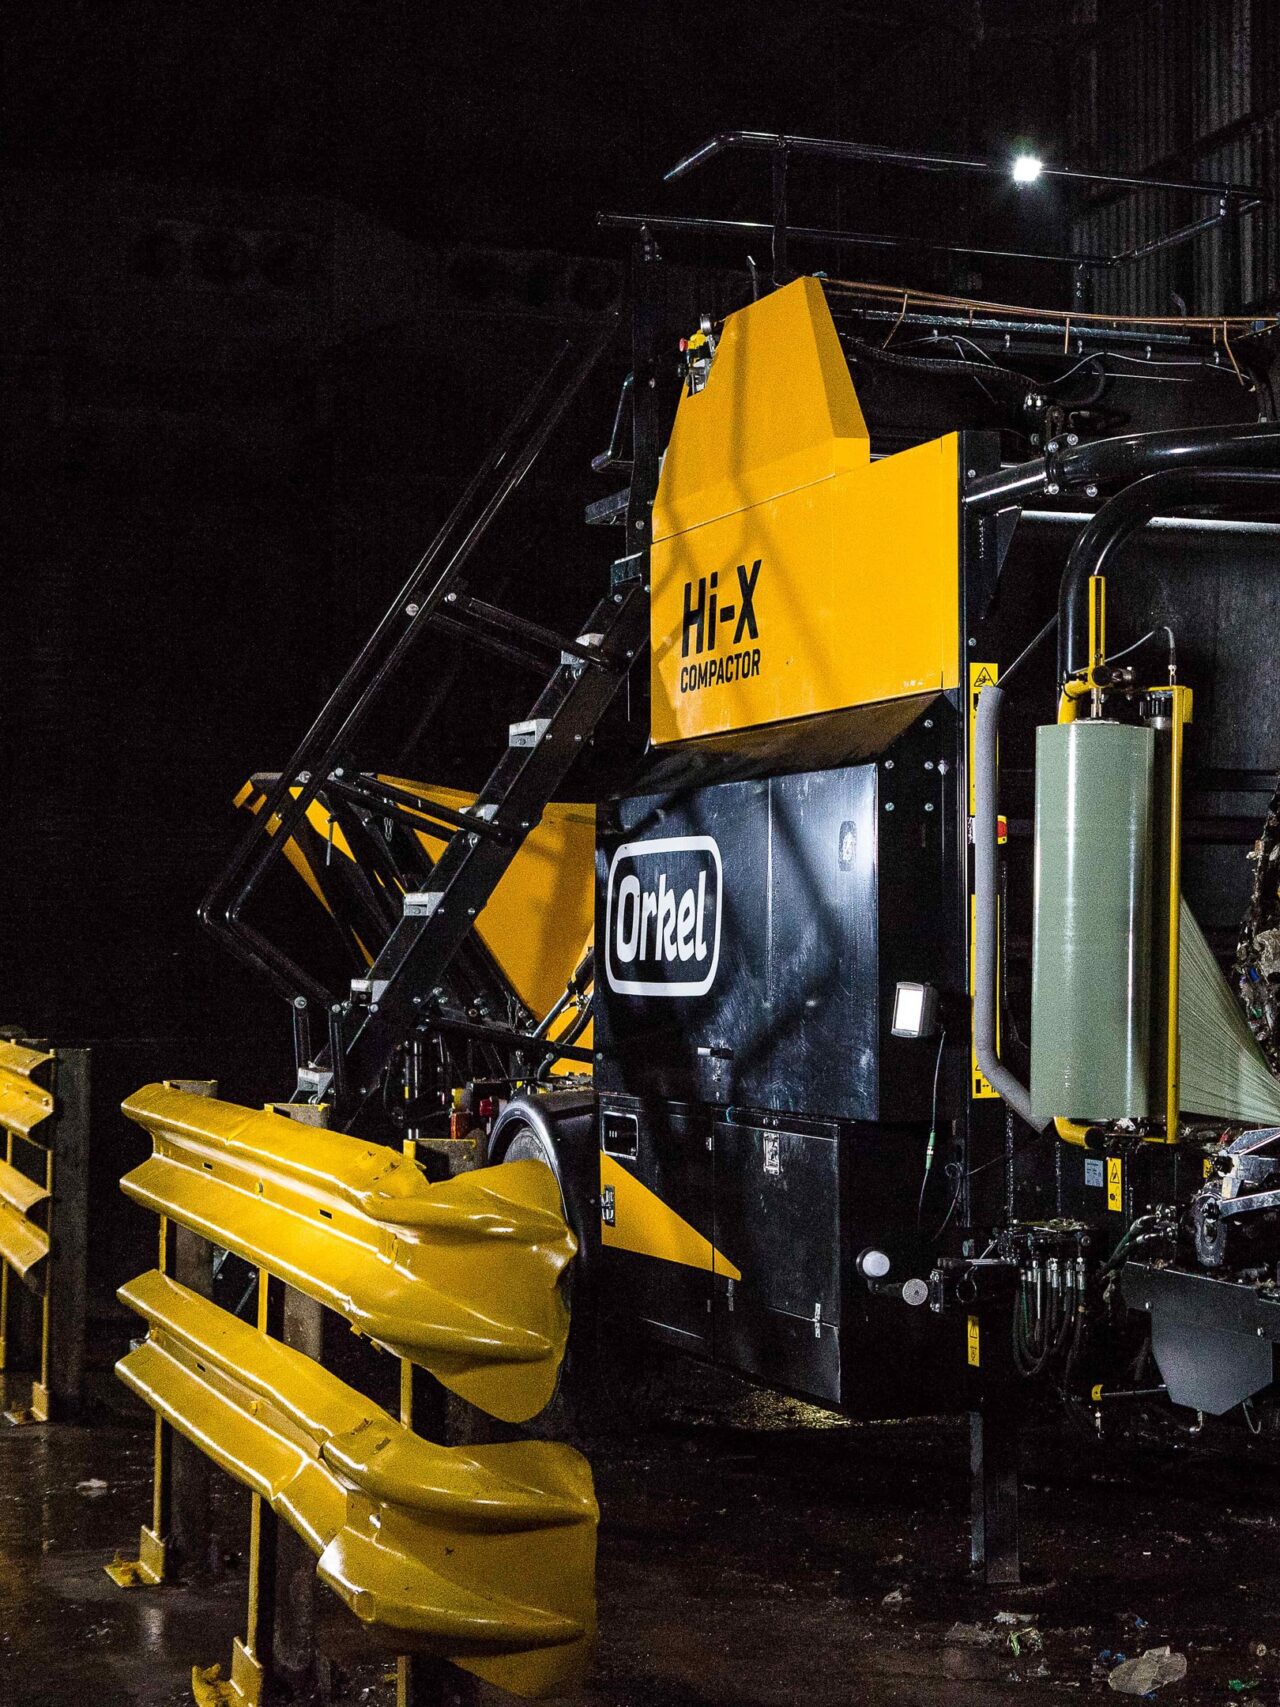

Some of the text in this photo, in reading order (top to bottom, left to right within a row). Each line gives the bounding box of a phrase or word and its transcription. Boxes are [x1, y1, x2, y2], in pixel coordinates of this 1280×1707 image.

[682, 559, 762, 658] Hi-X
[680, 649, 761, 693] COMPACTOR
[617, 870, 707, 962] Orkel
